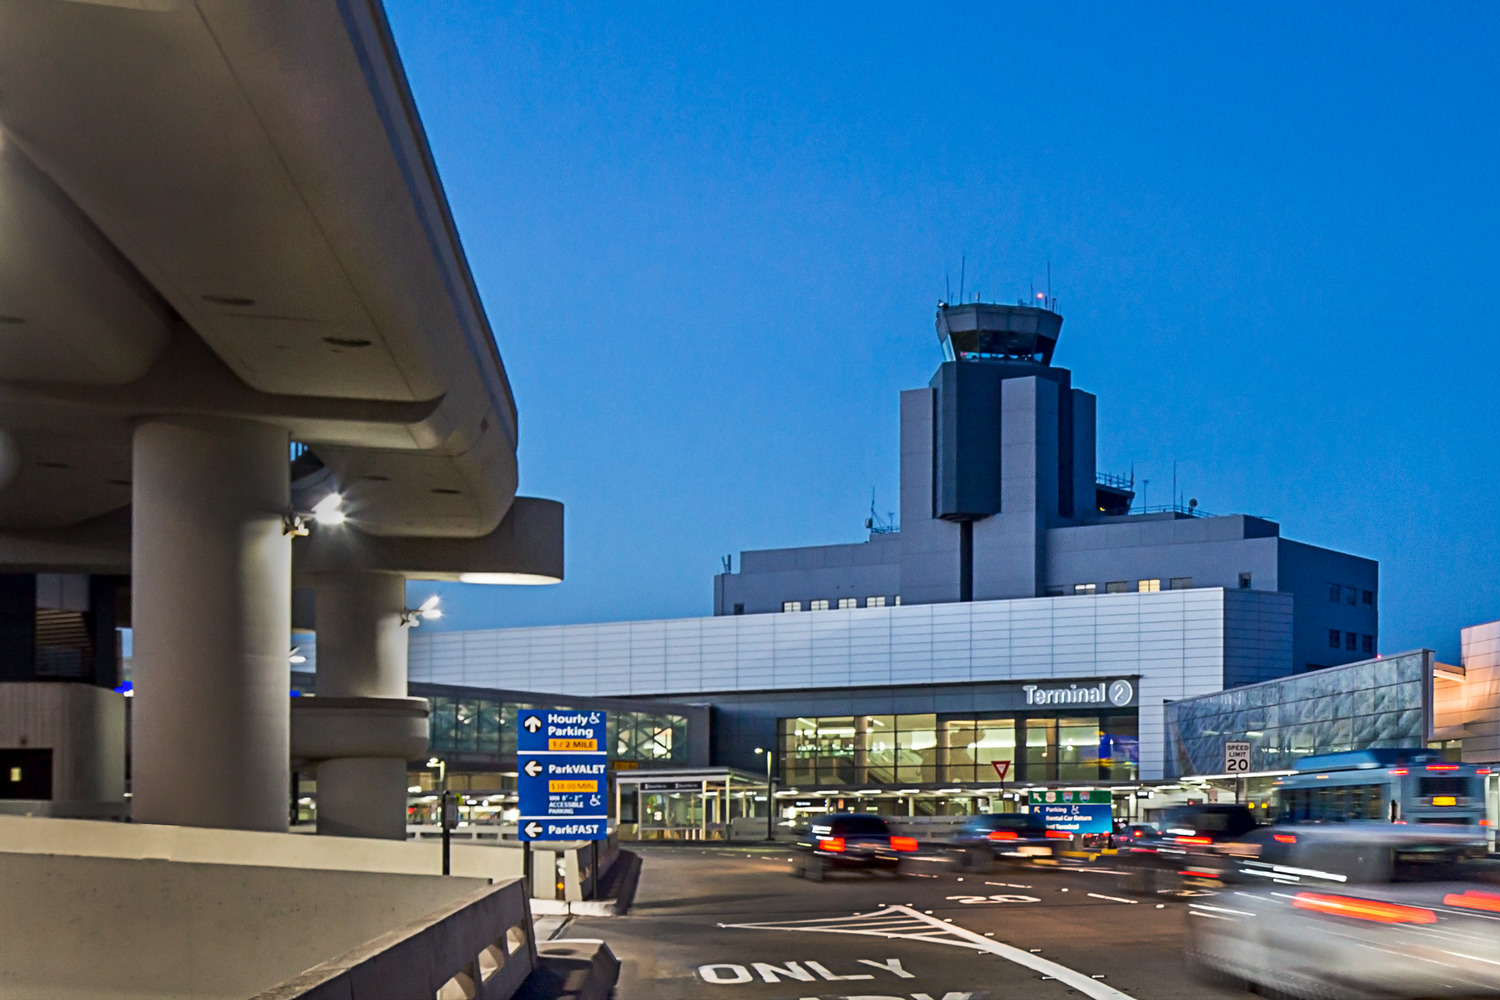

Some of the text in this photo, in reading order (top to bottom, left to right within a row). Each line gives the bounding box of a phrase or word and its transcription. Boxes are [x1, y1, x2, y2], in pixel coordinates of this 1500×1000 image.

[1022, 683, 1106, 705] Terminal
[548, 713, 589, 726] Hourly
[548, 726, 594, 739] Parking
[548, 764, 606, 774] ParkVALET
[1227, 759, 1248, 771] 20
[1045, 806, 1067, 814] Parking
[548, 824, 599, 835] ParkFAST
[945, 894, 1042, 904] 20
[697, 958, 916, 985] ONLY
